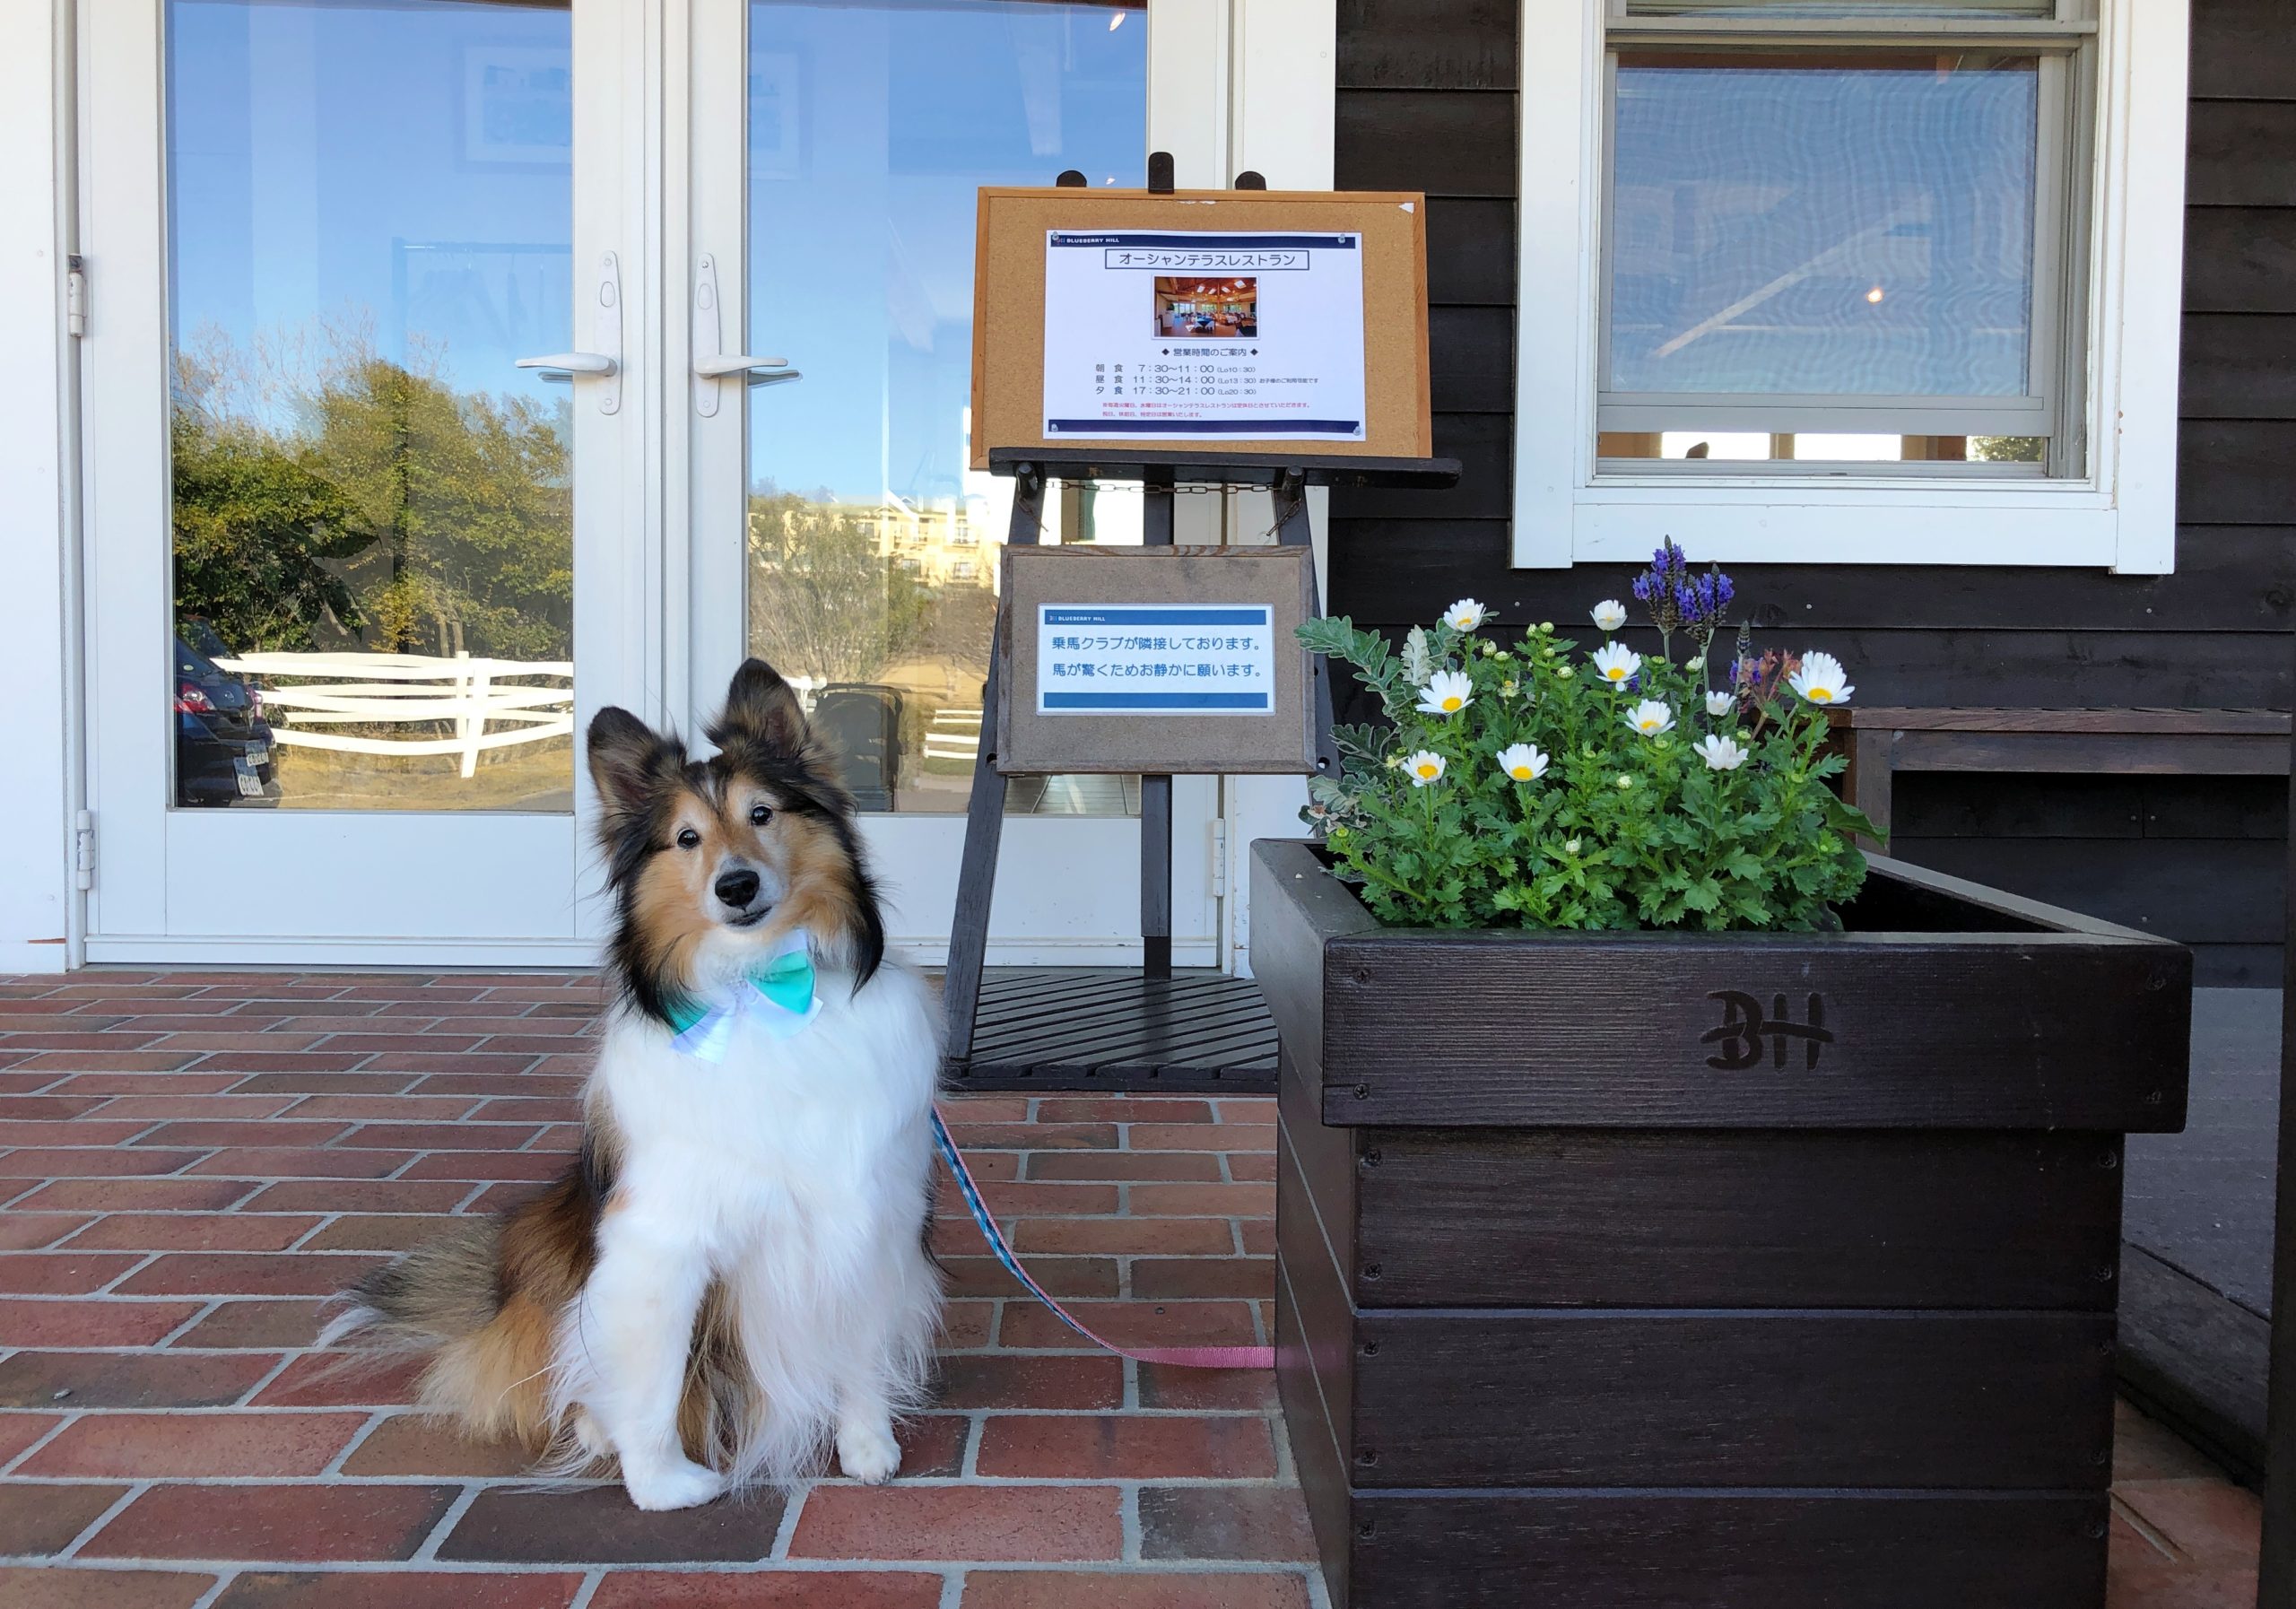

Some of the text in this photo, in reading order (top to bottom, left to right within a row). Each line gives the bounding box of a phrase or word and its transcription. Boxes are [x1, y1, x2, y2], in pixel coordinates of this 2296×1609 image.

[1118, 252, 1296, 267] オーシャンテラスレストラン
[1172, 347, 1248, 357] 営業時間のご案内
[1051, 636, 1260, 650] 乗馬クラブが隣接しております。
[1052, 663, 1261, 677] 馬が驚くためお静かに願います。
